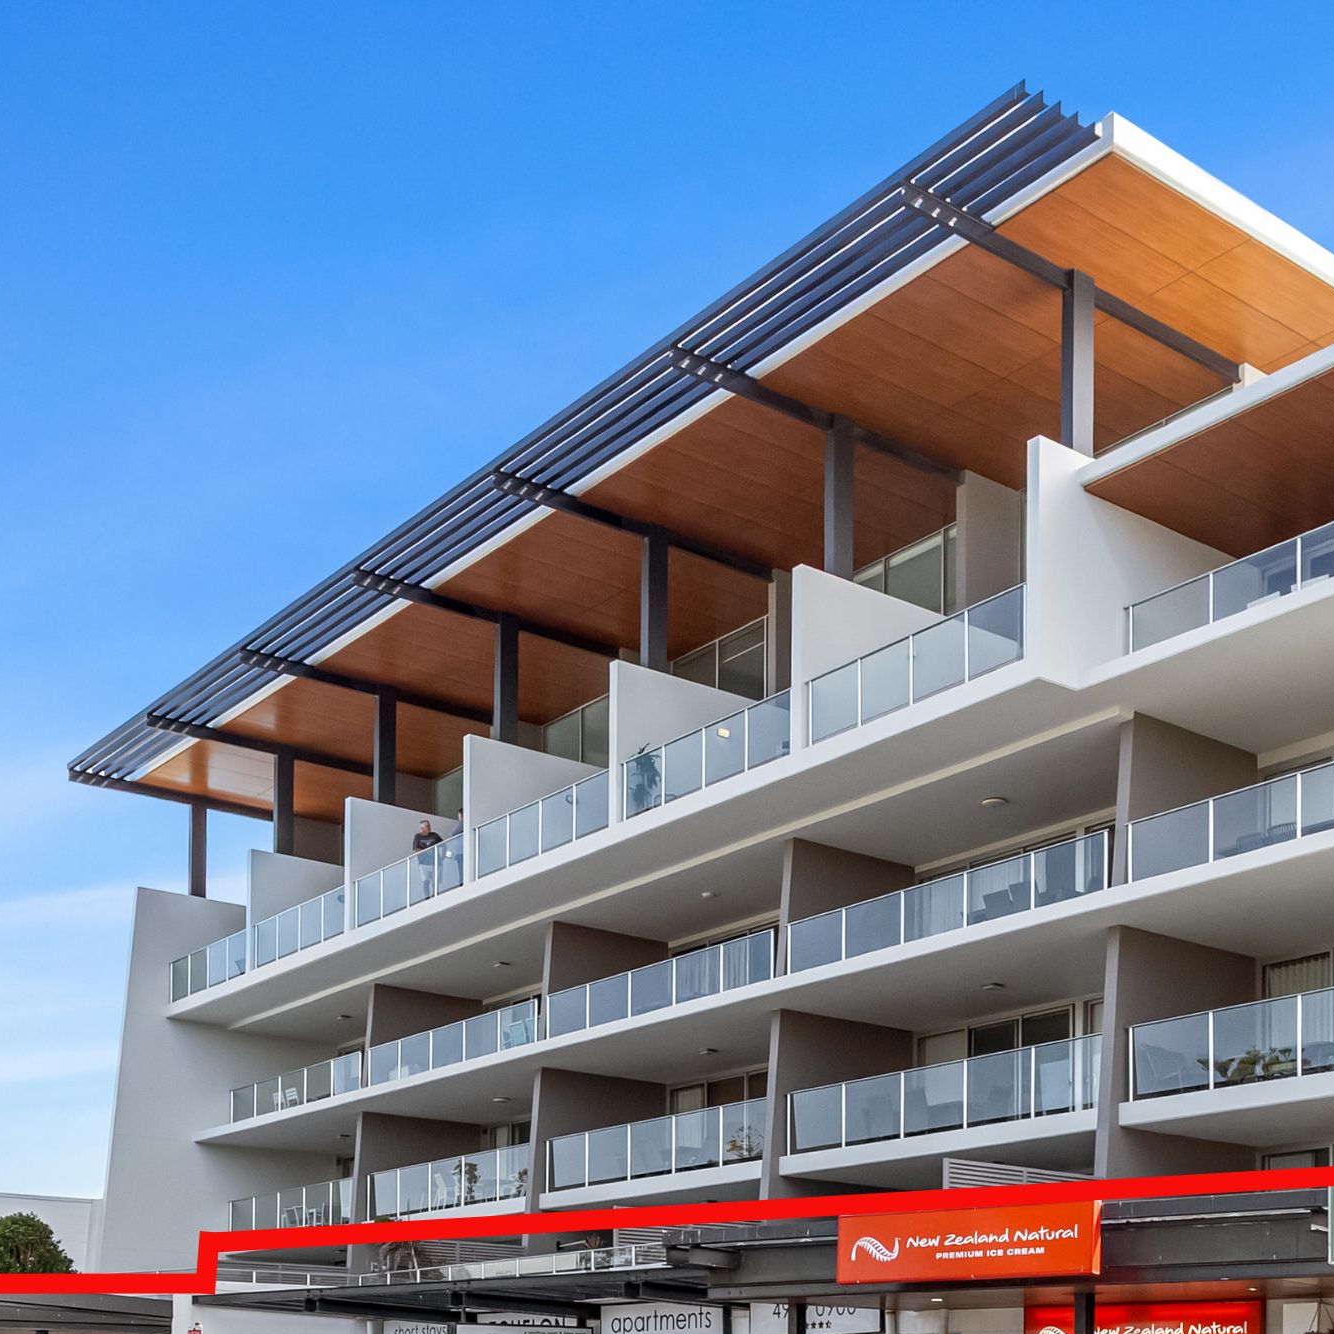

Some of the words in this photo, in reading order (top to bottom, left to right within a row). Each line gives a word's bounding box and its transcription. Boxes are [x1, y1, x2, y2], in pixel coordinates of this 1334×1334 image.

[906, 1236, 940, 1249] New
[944, 1228, 1009, 1246] Zealand
[1014, 1224, 1078, 1242] Natural
[935, 1250, 983, 1259] PREMIUM
[986, 1248, 1003, 1257] ICE
[1007, 1247, 1045, 1256] CREAM
[1188, 1321, 1247, 1334] Natural
